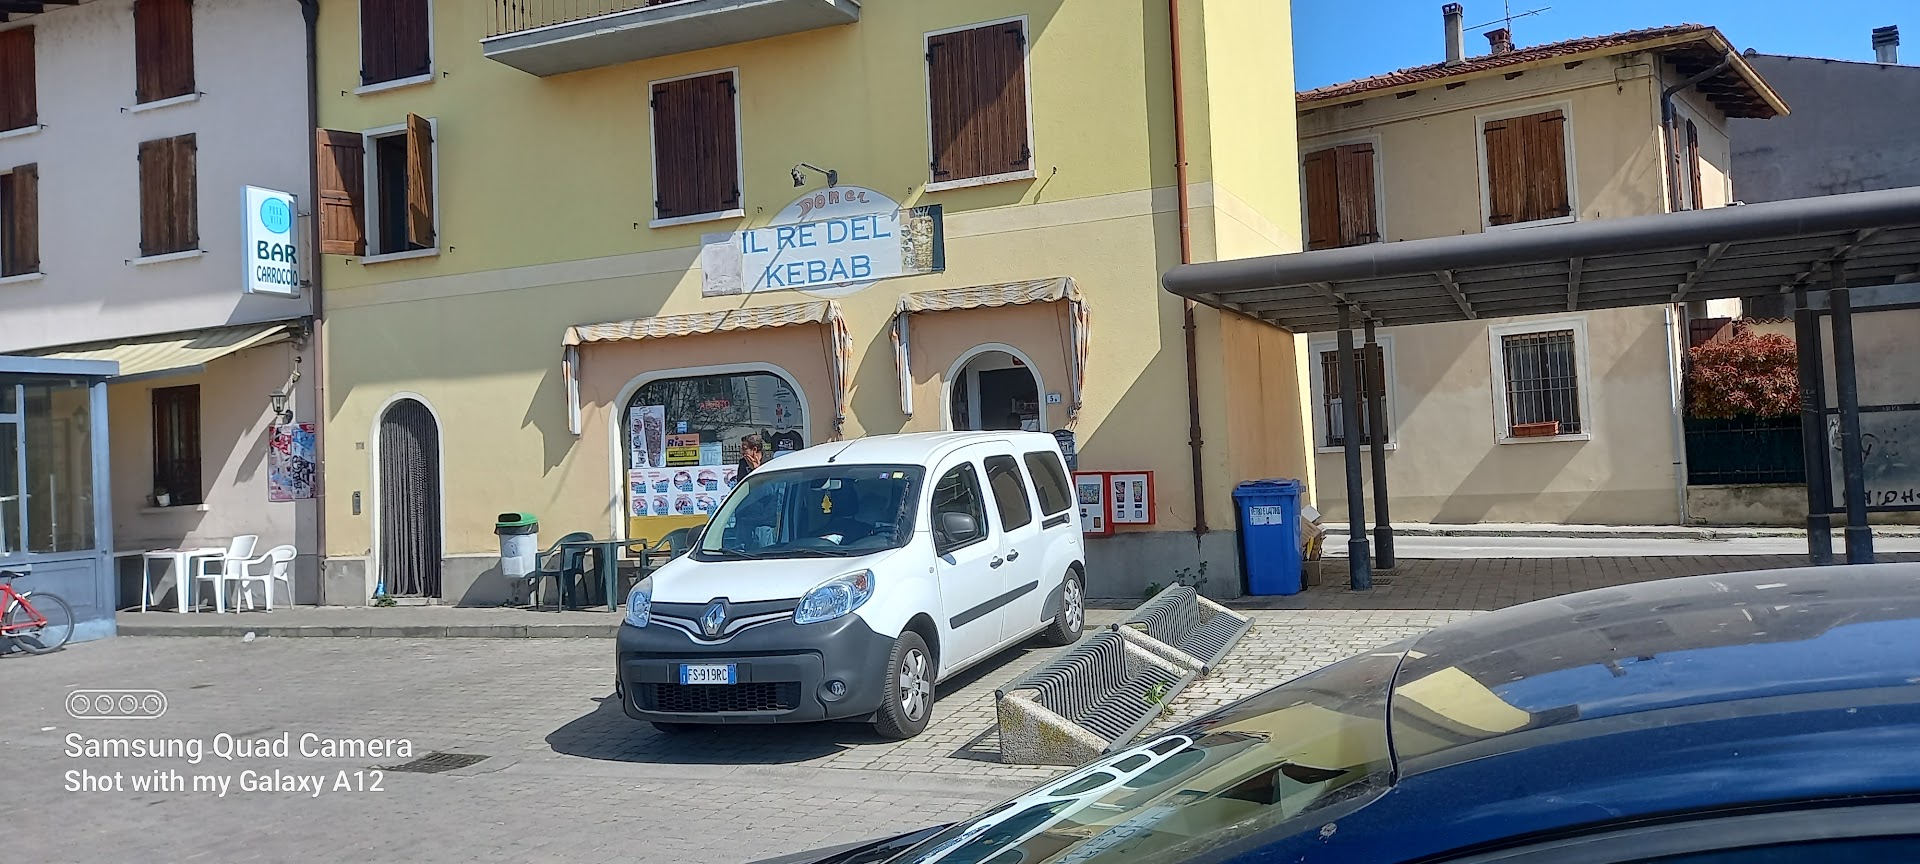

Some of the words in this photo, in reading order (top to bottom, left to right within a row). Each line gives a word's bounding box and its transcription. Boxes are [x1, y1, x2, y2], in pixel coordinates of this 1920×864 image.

[742, 231, 769, 255] IL
[777, 222, 817, 250] RE
[827, 215, 891, 245] DEL
[257, 239, 297, 264] BAR
[256, 265, 298, 287] CARROCCIO
[765, 254, 872, 288] KEBAB
[667, 436, 684, 447] Ria
